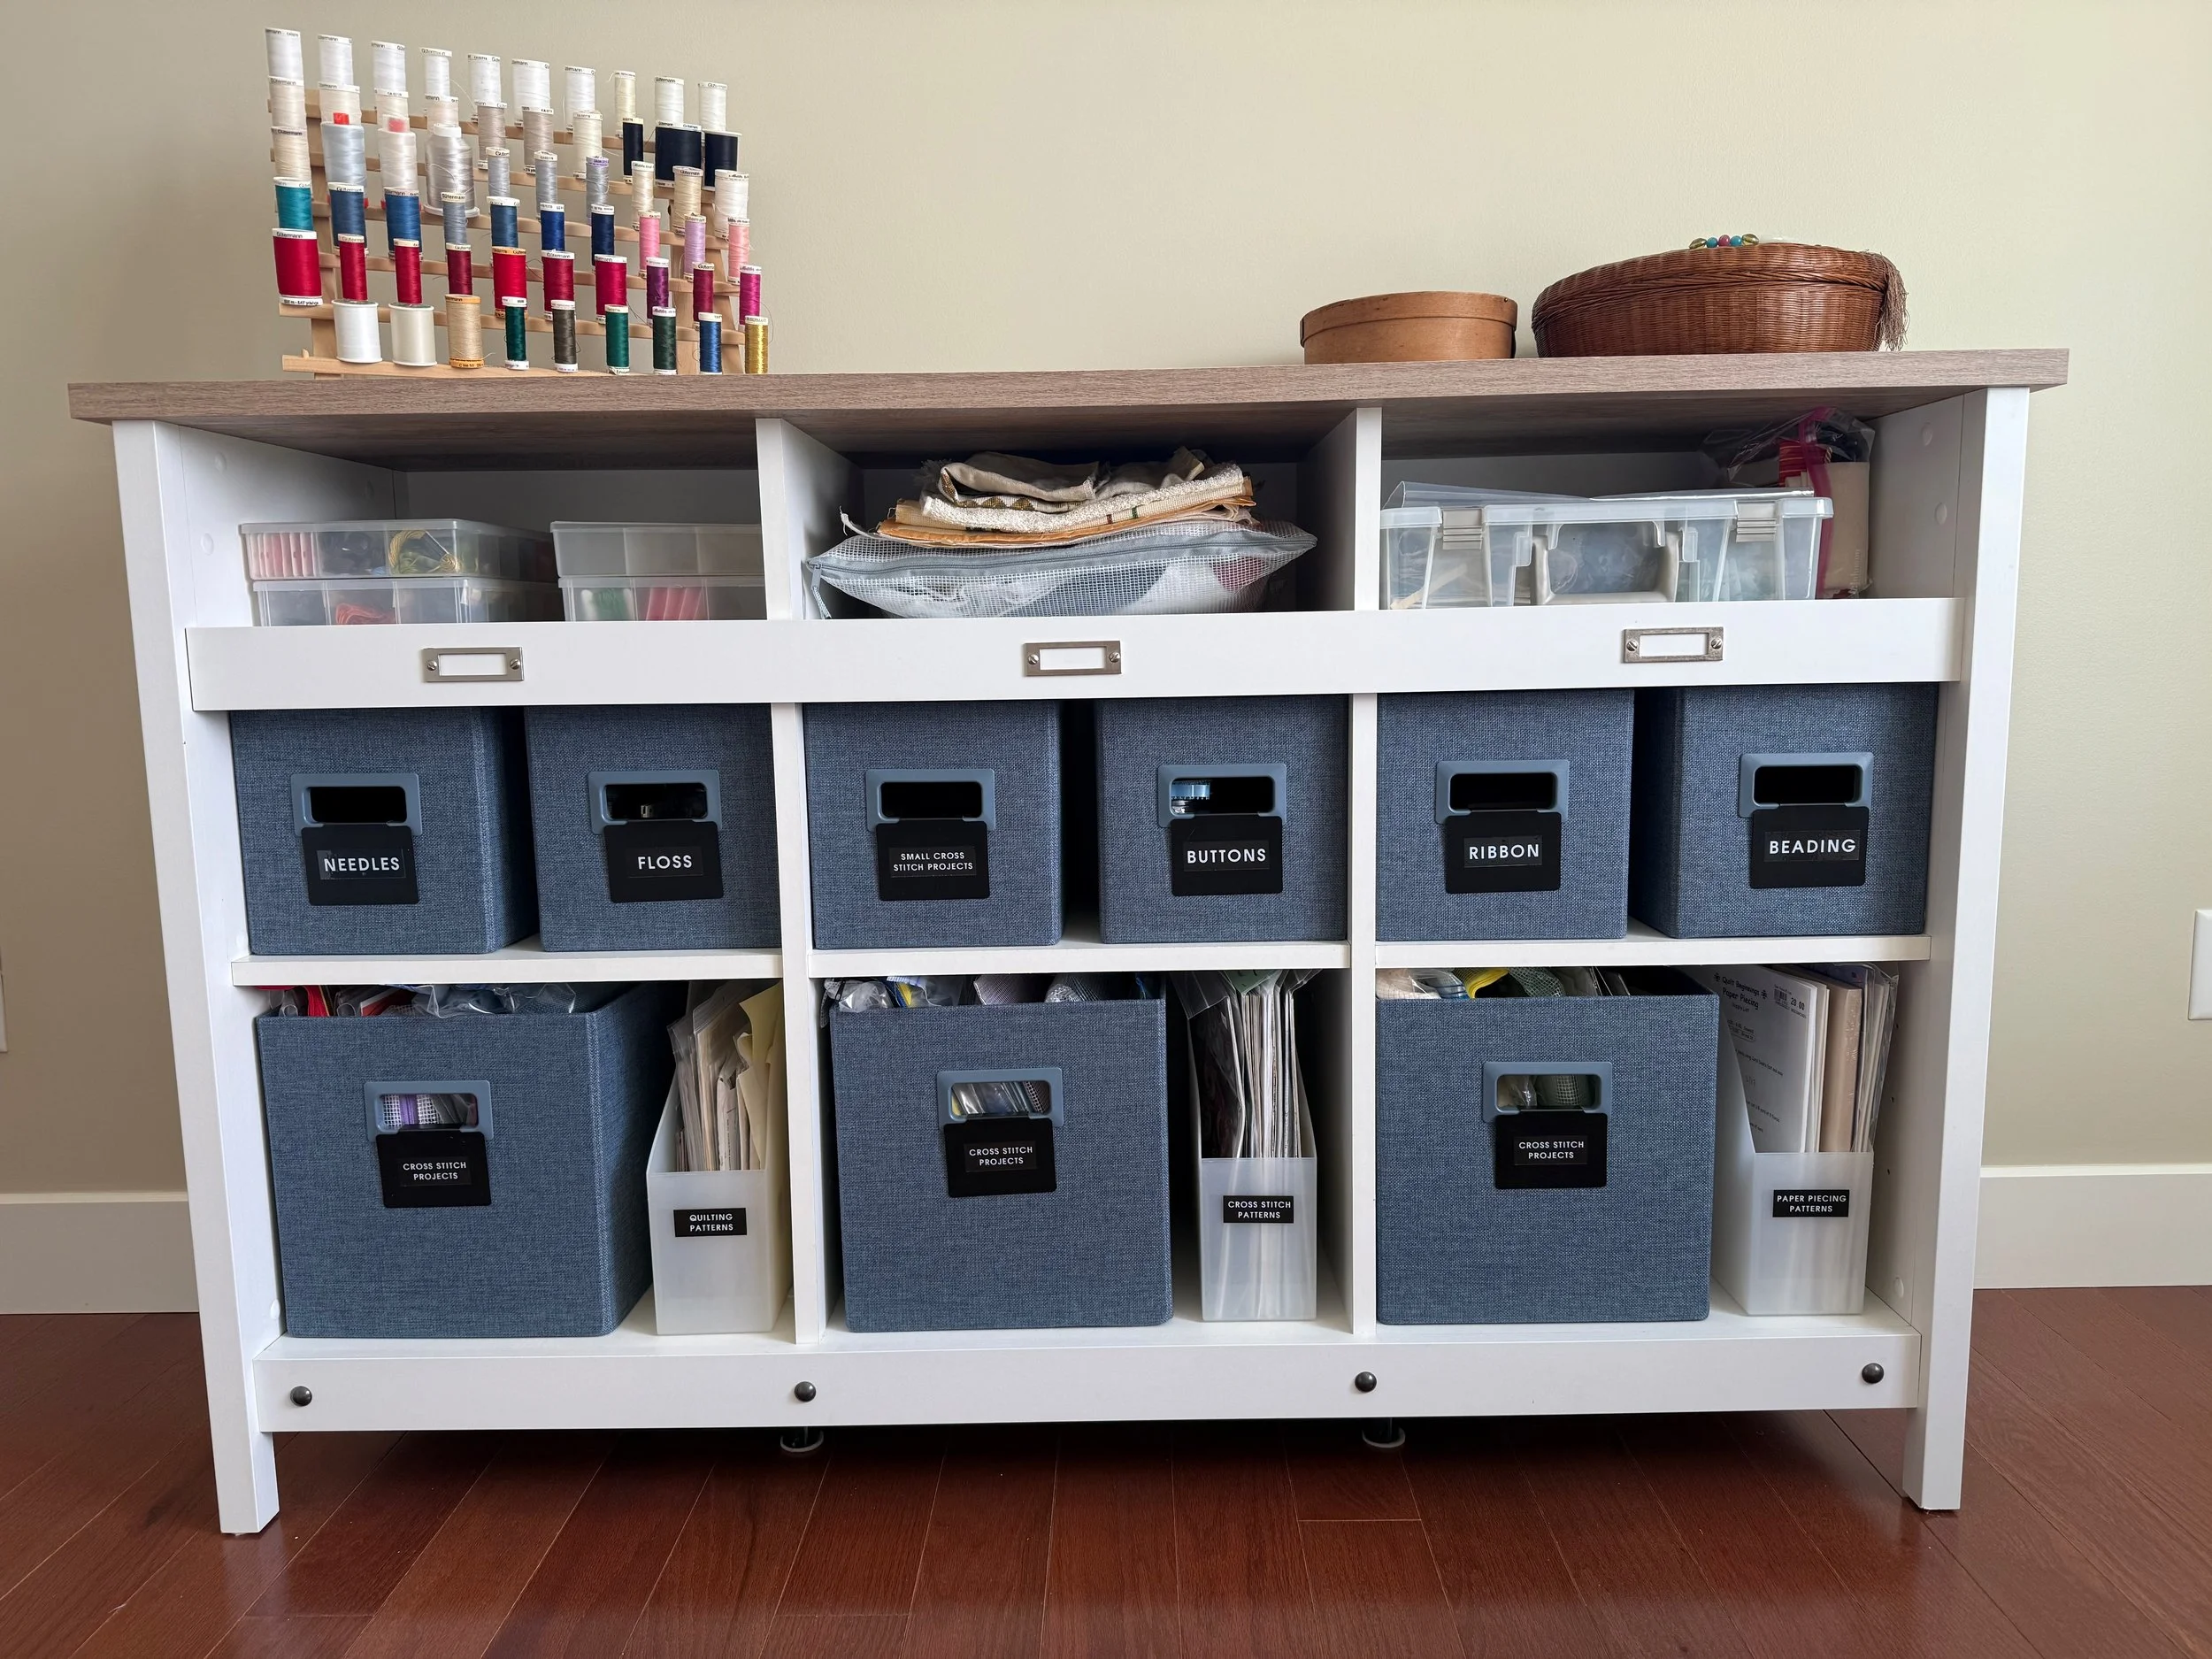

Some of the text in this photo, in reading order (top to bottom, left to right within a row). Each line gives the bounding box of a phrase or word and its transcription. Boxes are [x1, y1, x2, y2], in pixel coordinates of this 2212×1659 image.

[1469, 844, 1539, 860] RIBBON
[1770, 839, 1856, 855] BEADING
[638, 855, 692, 870] FLOSS
[1187, 849, 1266, 864] BUTTONS
[324, 857, 400, 872] NEEDLES
[927, 862, 973, 871] PROJECTS
[969, 1146, 1033, 1156] CROSS STITCH
[979, 1156, 1024, 1166] PROJECTS
[689, 1213, 733, 1222] QUILTING
